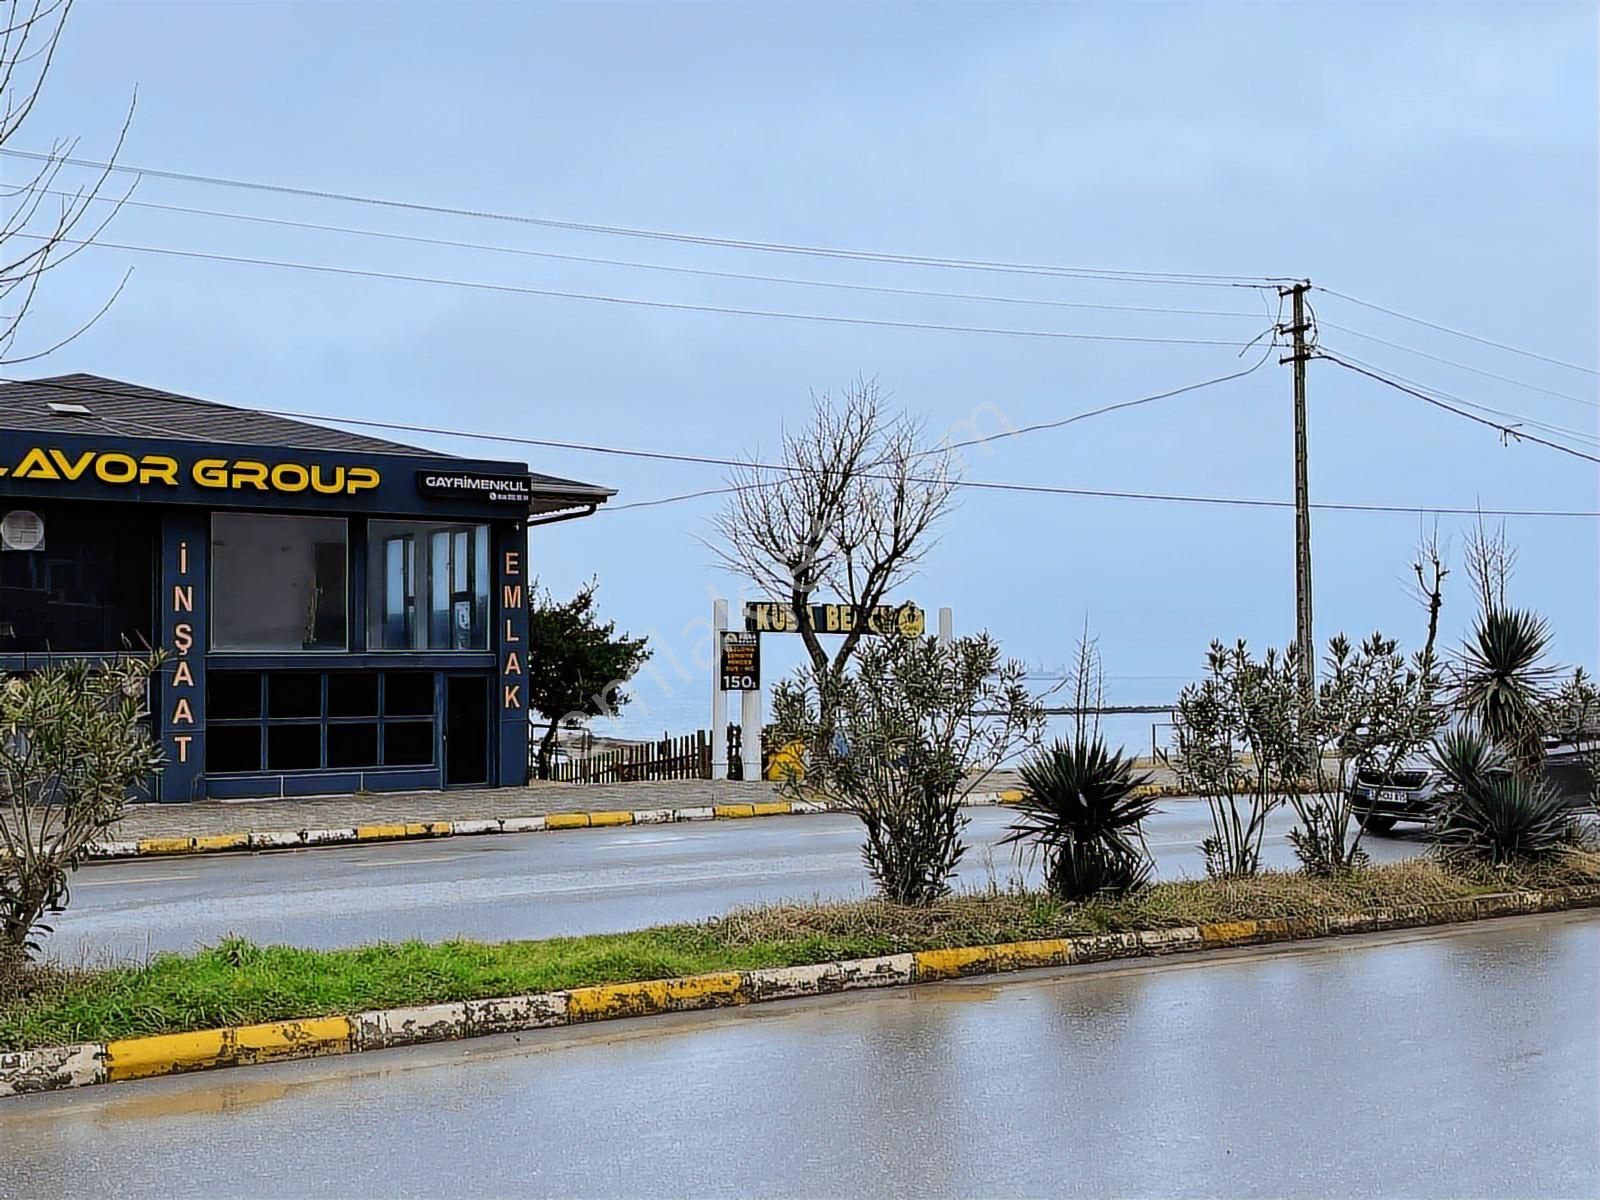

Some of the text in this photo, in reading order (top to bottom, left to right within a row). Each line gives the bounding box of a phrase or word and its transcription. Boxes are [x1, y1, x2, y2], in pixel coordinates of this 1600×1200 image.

[0, 447, 381, 495] AVOR GROUP
[425, 475, 529, 492] GAYRİMENKUL
[504, 551, 522, 709] EMLAK
[826, 605, 896, 633] BECH
[172, 541, 194, 763] İNŞAAT
